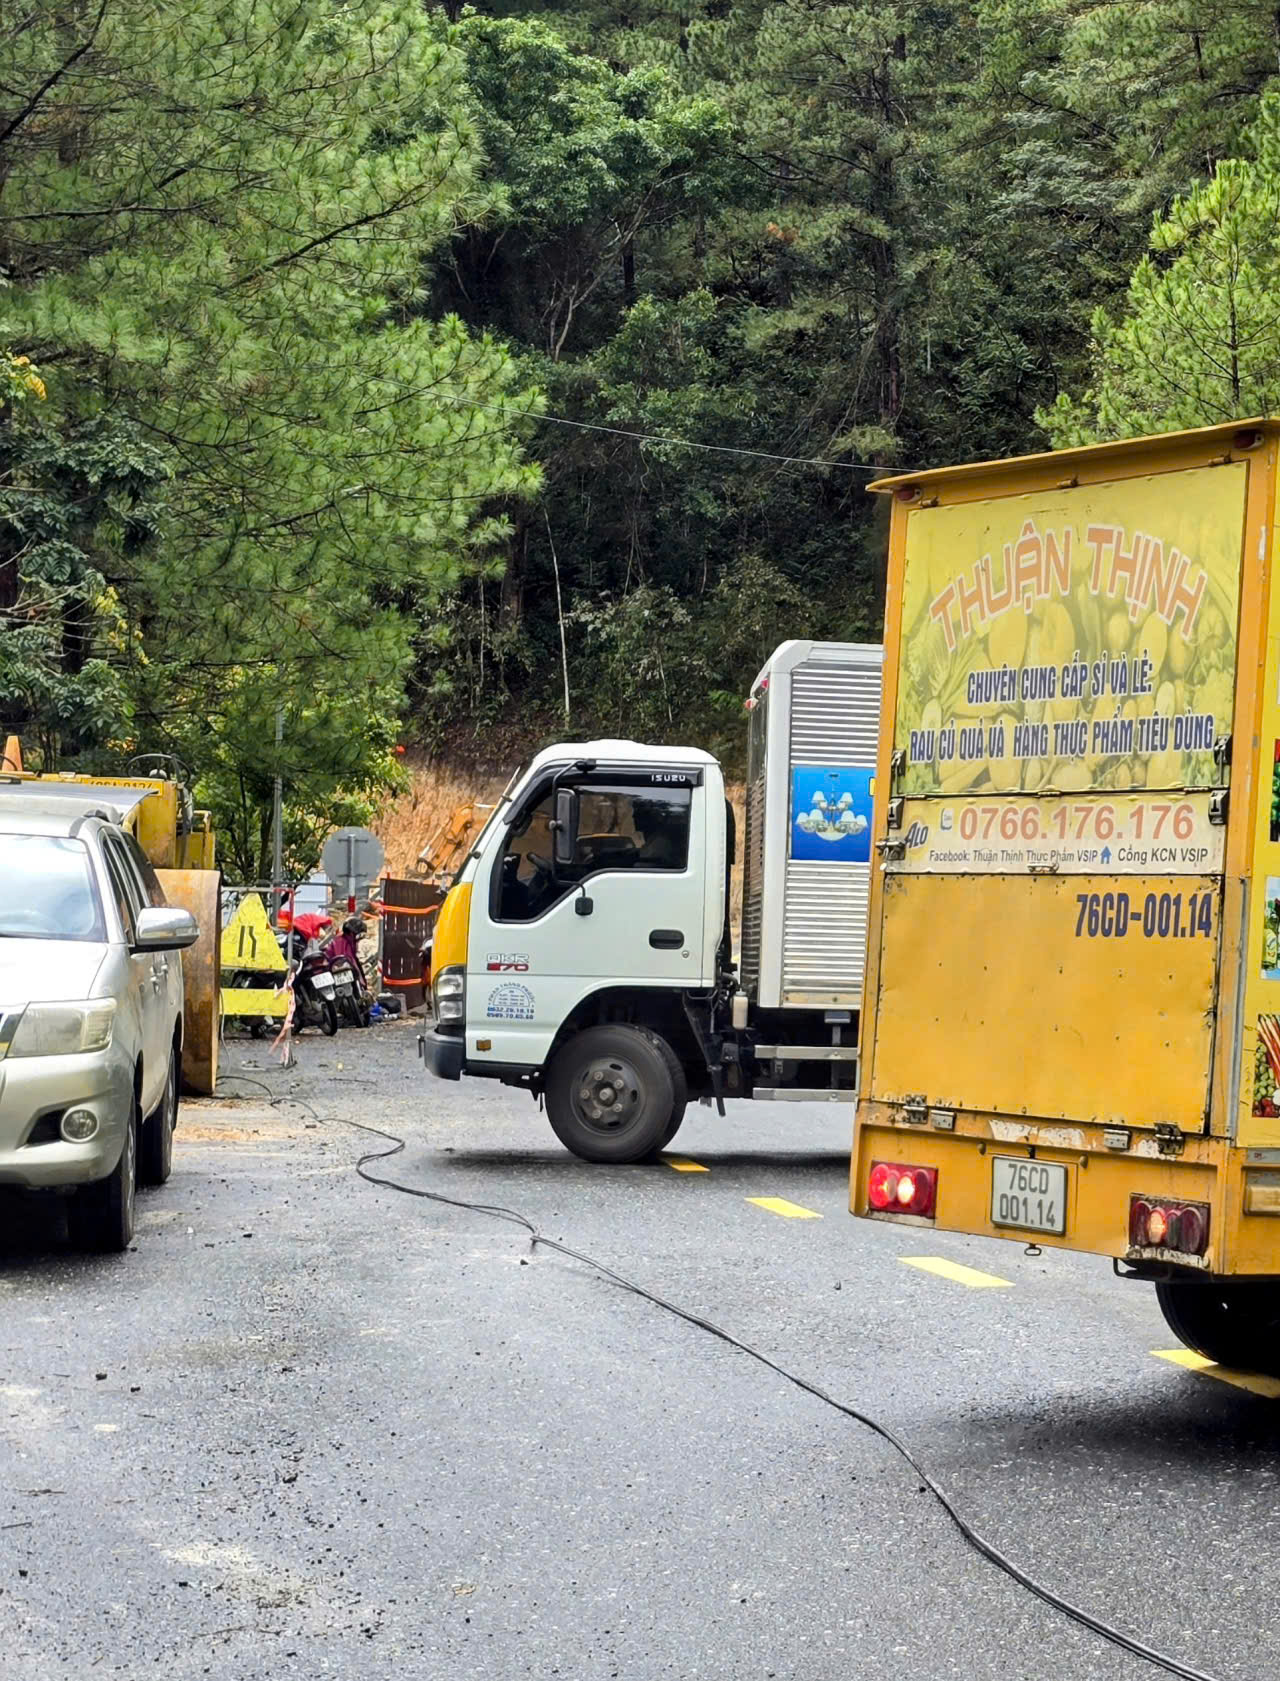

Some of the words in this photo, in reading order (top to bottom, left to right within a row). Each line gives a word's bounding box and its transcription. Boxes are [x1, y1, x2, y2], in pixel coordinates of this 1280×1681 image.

[930, 519, 1072, 652] THUẬN
[1087, 524, 1208, 640] THỊNH
[967, 663, 1017, 704] CHUYÊN
[1021, 666, 1056, 700] CUNG
[1060, 652, 1088, 698] CẤP
[1092, 652, 1106, 696] SỈ
[1111, 654, 1127, 695] VÀ
[910, 730, 935, 762] RAU
[939, 719, 956, 760] CỦ
[959, 718, 984, 760] QUẢ
[988, 719, 1004, 758] VÀ
[1013, 718, 1049, 757] HÀNG
[1053, 719, 1088, 762] THỰC
[1092, 705, 1134, 754] PHẨM
[1138, 711, 1169, 752] TIÊU
[1173, 709, 1214, 751] DÙNG
[651, 774, 686, 782] ISUZU
[904, 821, 929, 849] ALO
[959, 804, 1194, 841] 0766.176.176
[929, 850, 970, 862] Facebook:
[1077, 849, 1098, 862] VSIP
[1151, 848, 1177, 862] KCN
[1180, 848, 1208, 863] VSIP
[1075, 892, 1212, 938] 76CD-001.14
[1007, 1163, 1050, 1194] 76CD
[1000, 1193, 1056, 1228] 001.14
